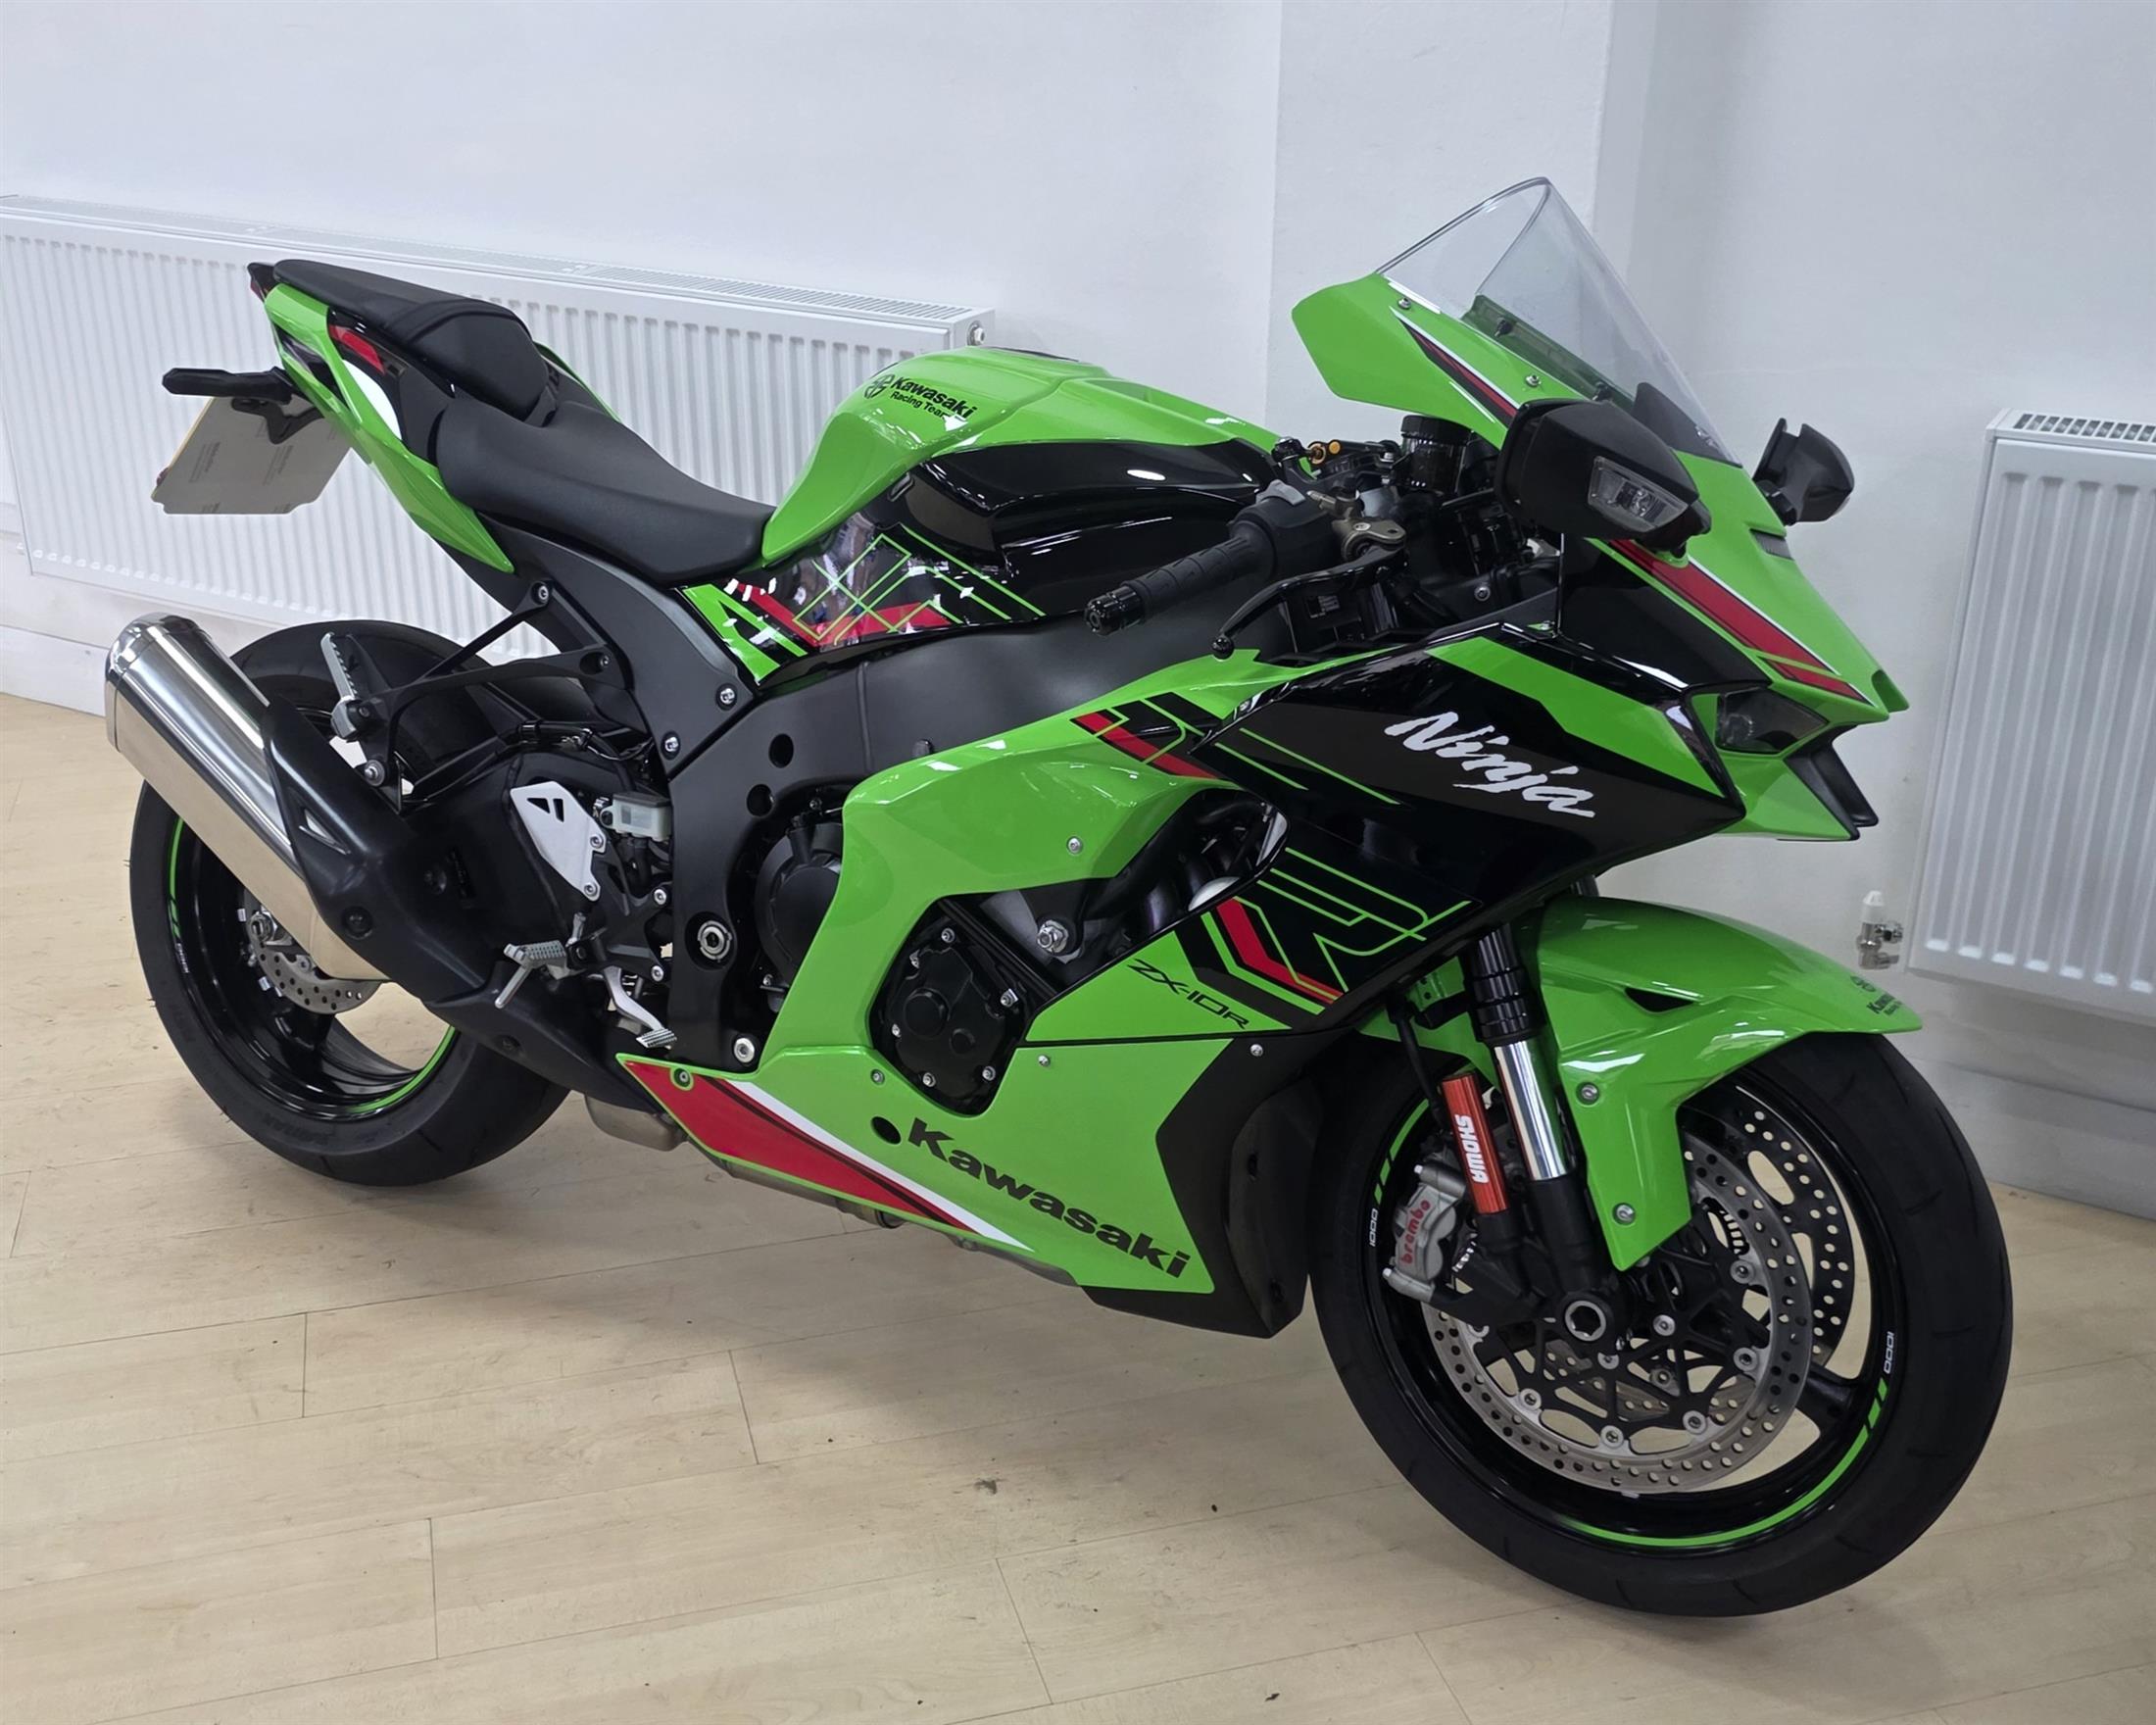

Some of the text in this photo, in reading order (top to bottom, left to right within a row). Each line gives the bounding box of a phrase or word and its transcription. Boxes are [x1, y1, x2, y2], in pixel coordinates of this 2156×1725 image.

[890, 376, 978, 419] Kawasaki
[890, 391, 923, 409] Racing
[1383, 711, 1596, 818] Ninja
[1127, 958, 1250, 1030] ZX-10R
[1454, 1113, 1491, 1185] SHOWA
[907, 1116, 1192, 1279] Kawasaki
[1369, 1208, 1378, 1247] 1000
[1400, 1200, 1431, 1264] brembo
[1883, 1330, 1894, 1374] 1000
